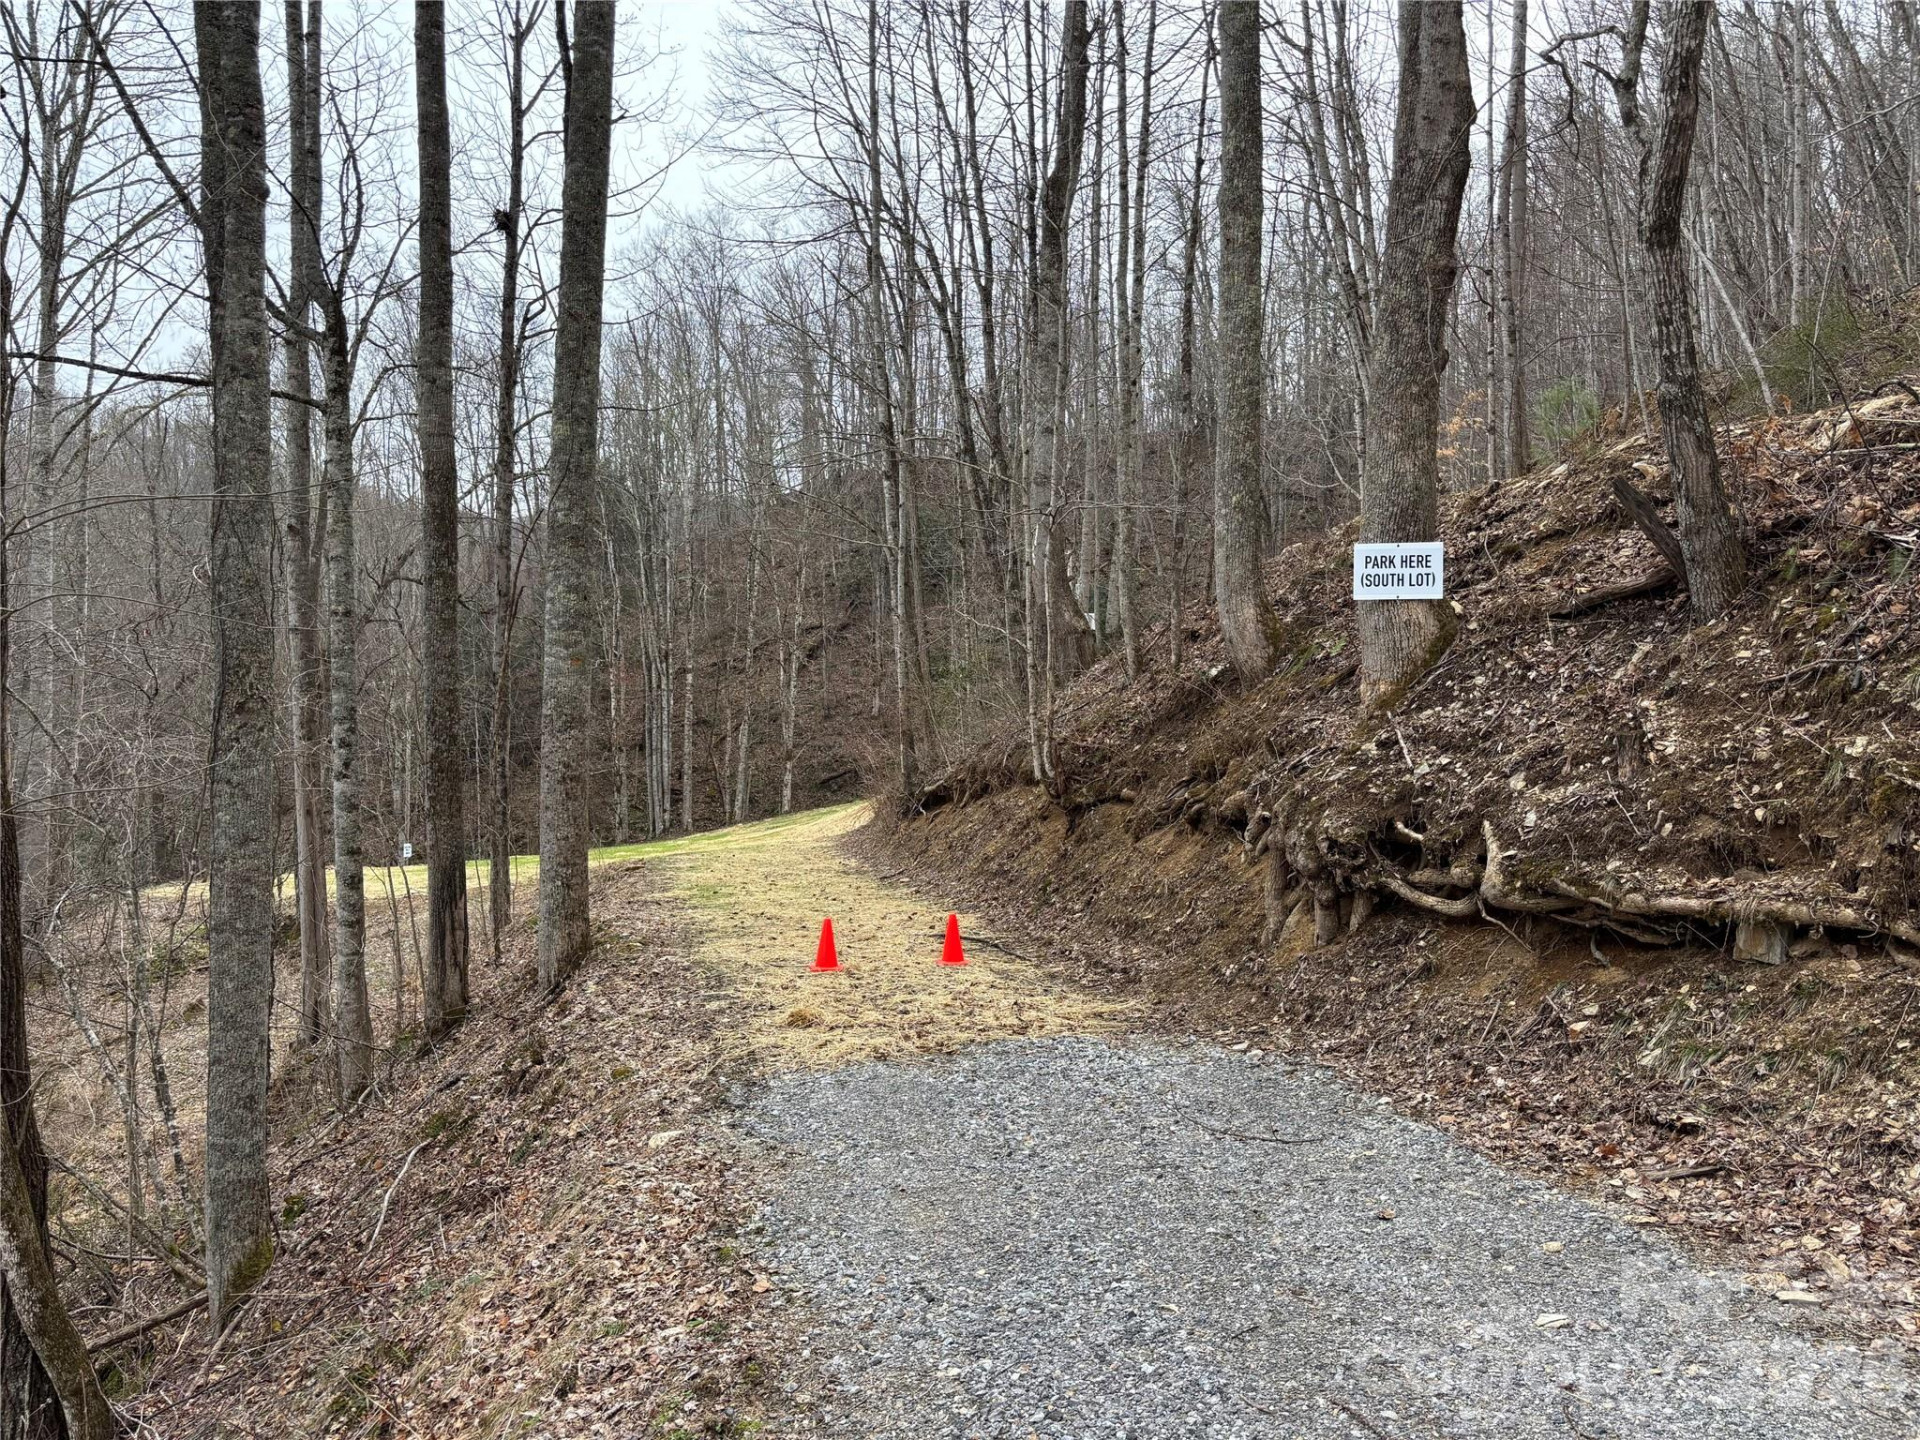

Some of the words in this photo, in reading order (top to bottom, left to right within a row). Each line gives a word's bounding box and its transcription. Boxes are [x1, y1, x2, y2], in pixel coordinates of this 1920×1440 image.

[1364, 555, 1396, 569] PARK
[1400, 555, 1432, 568] HERE
[1361, 572, 1405, 587] (SOUTH
[1408, 572, 1436, 587] LOT)
